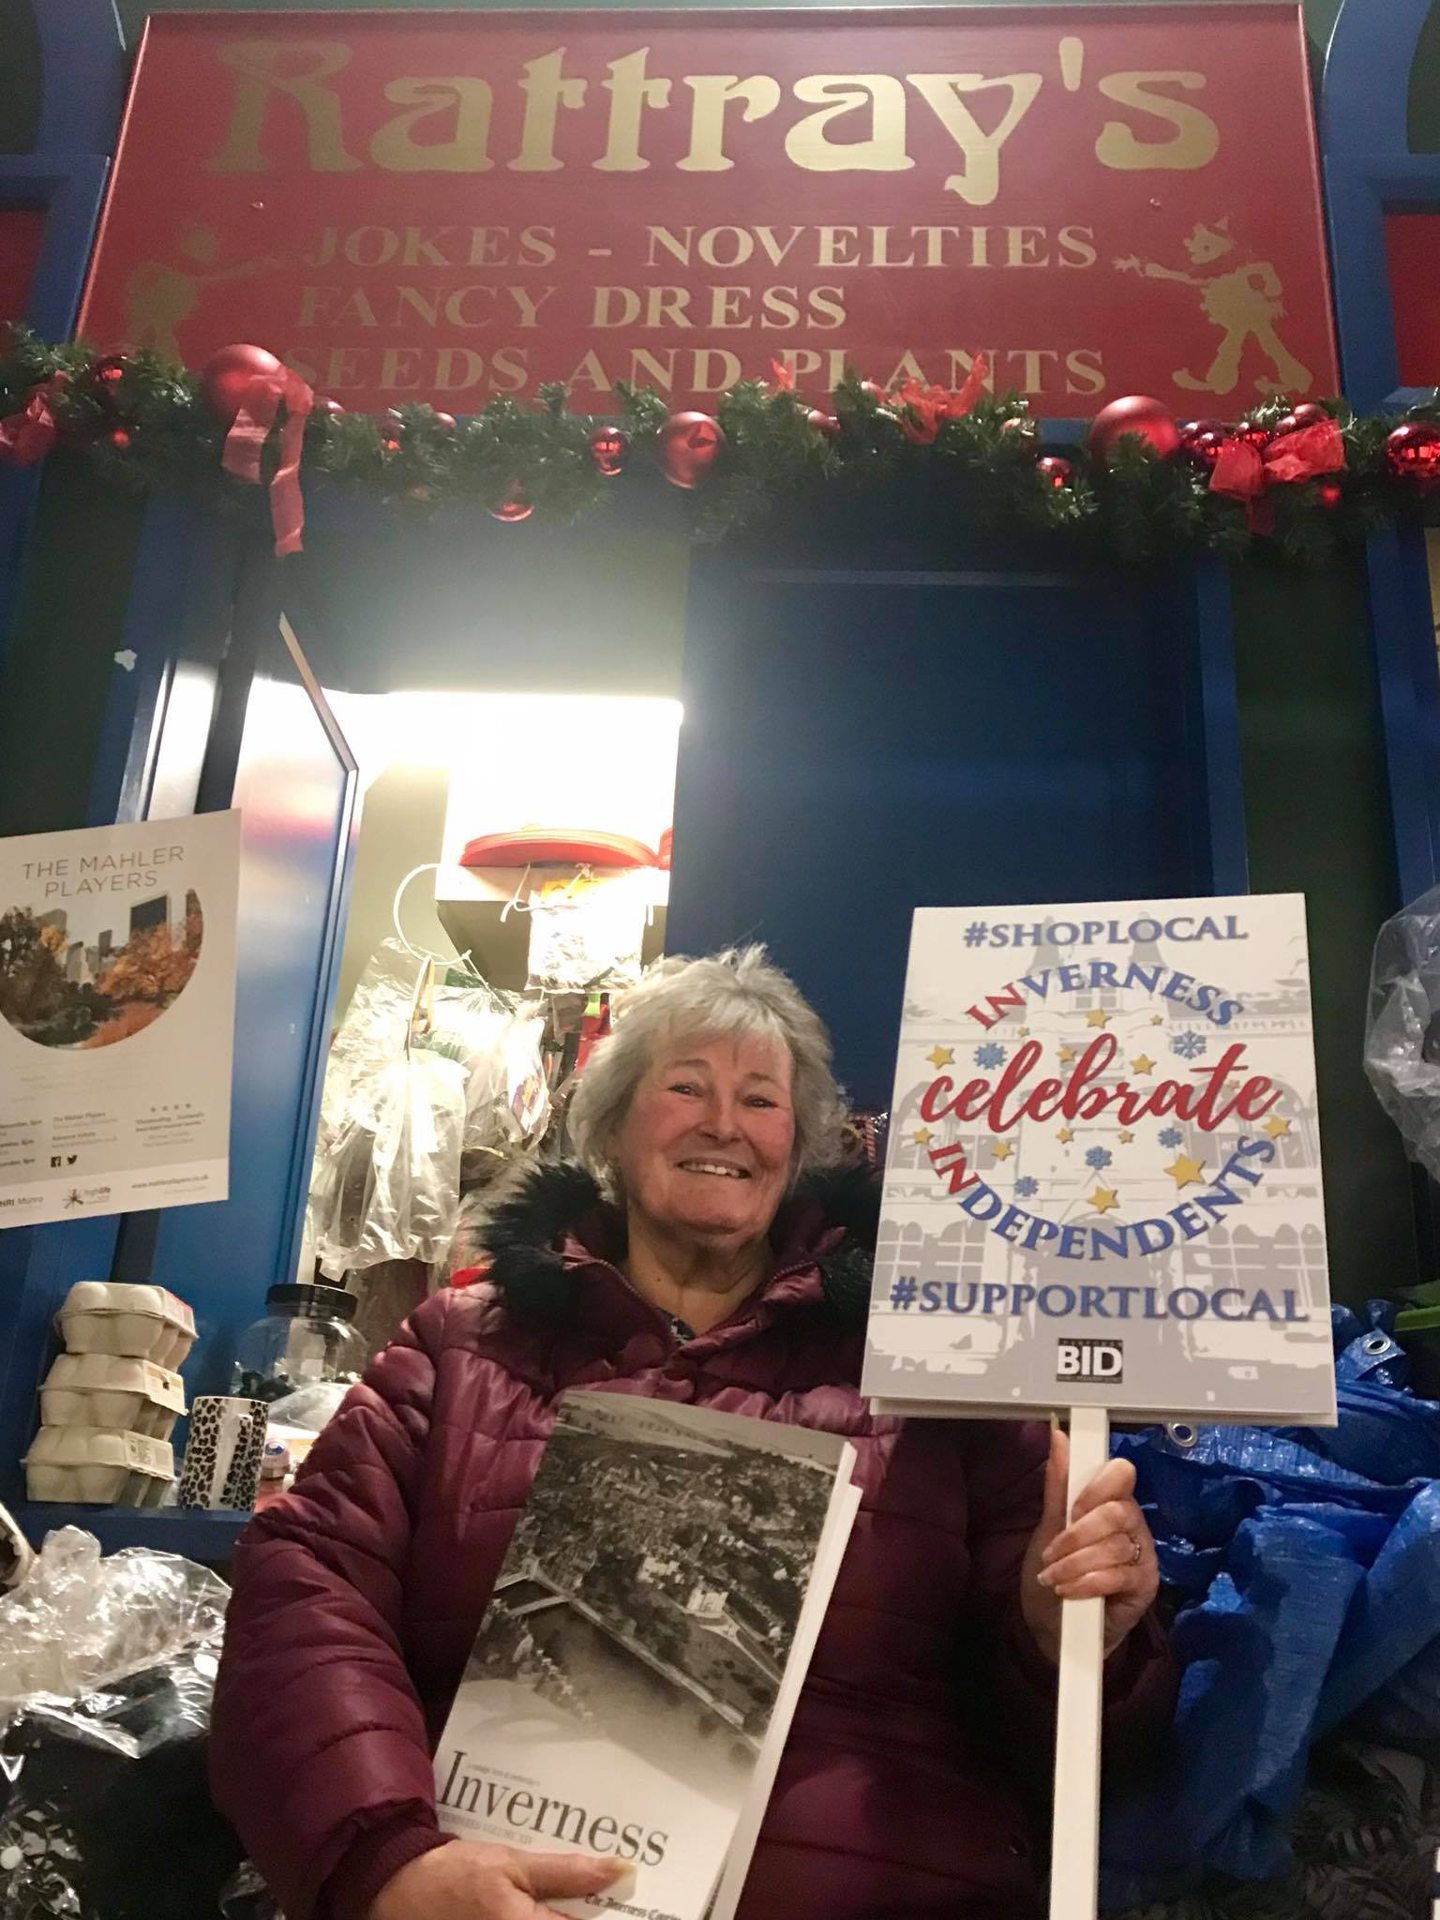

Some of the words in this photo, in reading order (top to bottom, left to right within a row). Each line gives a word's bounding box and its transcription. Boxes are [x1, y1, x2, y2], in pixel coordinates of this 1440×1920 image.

[207, 36, 1221, 206] Rattray's
[304, 225, 557, 268] JOKES
[646, 225, 1097, 269] NOVELTIES
[299, 285, 561, 330] FANCY
[591, 285, 846, 330] DRESS
[282, 346, 529, 391] SEEDS
[566, 347, 741, 393] AND
[22, 861, 69, 881] THE
[79, 845, 184, 874] MAHLER
[45, 870, 158, 898] PLAYERS
[963, 914, 1248, 949] #SHOPLOCAL
[966, 960, 1244, 1031] INVERNESS
[920, 1032, 1283, 1133] celebrate
[928, 1133, 1276, 1260] INDEPENDENTS
[890, 1276, 1310, 1322] #SUPPORTLOCAL
[1057, 1345, 1123, 1376] BID
[437, 1750, 669, 1867] Inverness
